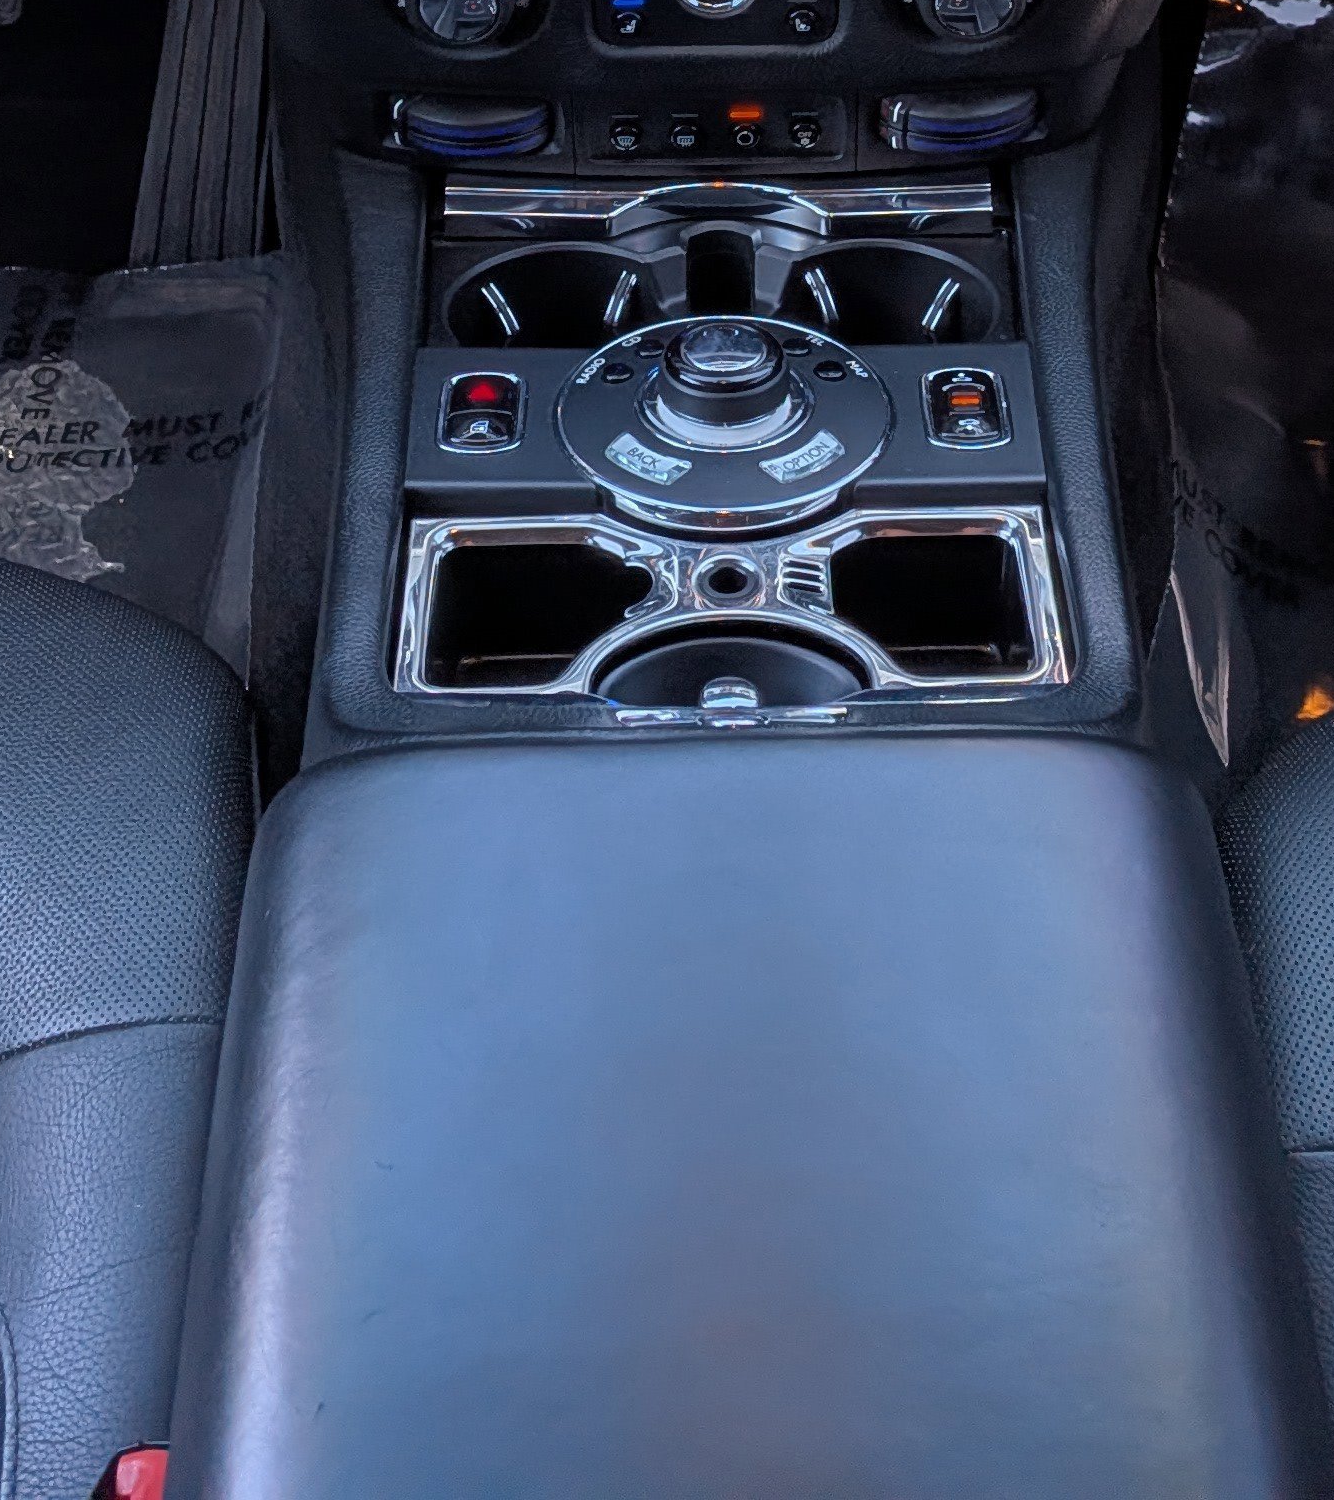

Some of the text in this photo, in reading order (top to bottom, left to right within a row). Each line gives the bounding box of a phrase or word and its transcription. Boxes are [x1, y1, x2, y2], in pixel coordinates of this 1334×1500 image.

[621, 335, 642, 348] CD
[804, 334, 824, 348] TEL
[575, 357, 606, 385] RADIO
[122, 409, 224, 438] MUST
[627, 446, 661, 470] BACK
[781, 440, 829, 471] OPTION
